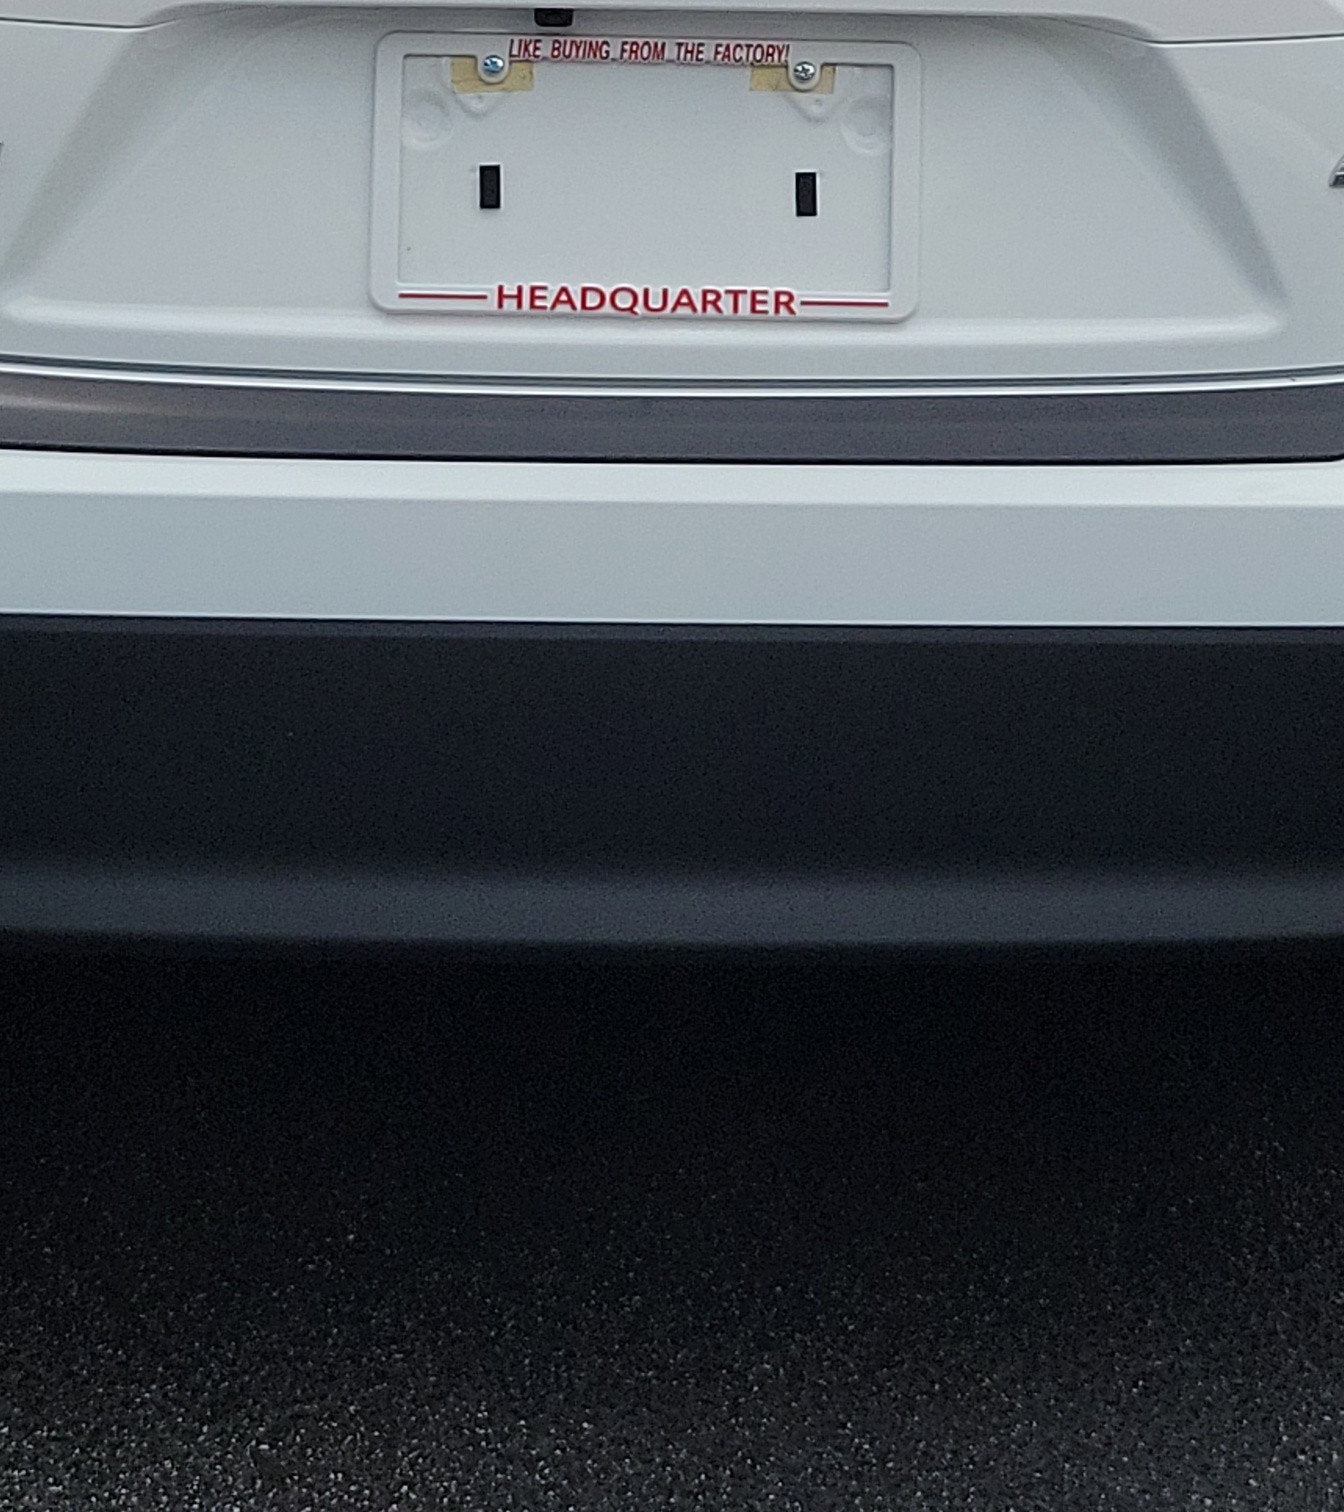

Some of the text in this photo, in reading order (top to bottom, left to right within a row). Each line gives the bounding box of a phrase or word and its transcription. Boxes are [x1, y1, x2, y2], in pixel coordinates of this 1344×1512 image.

[508, 38, 791, 64] LIKE BUYING FROM THE FACTORY!
[496, 284, 797, 315] HEADQUARTER
